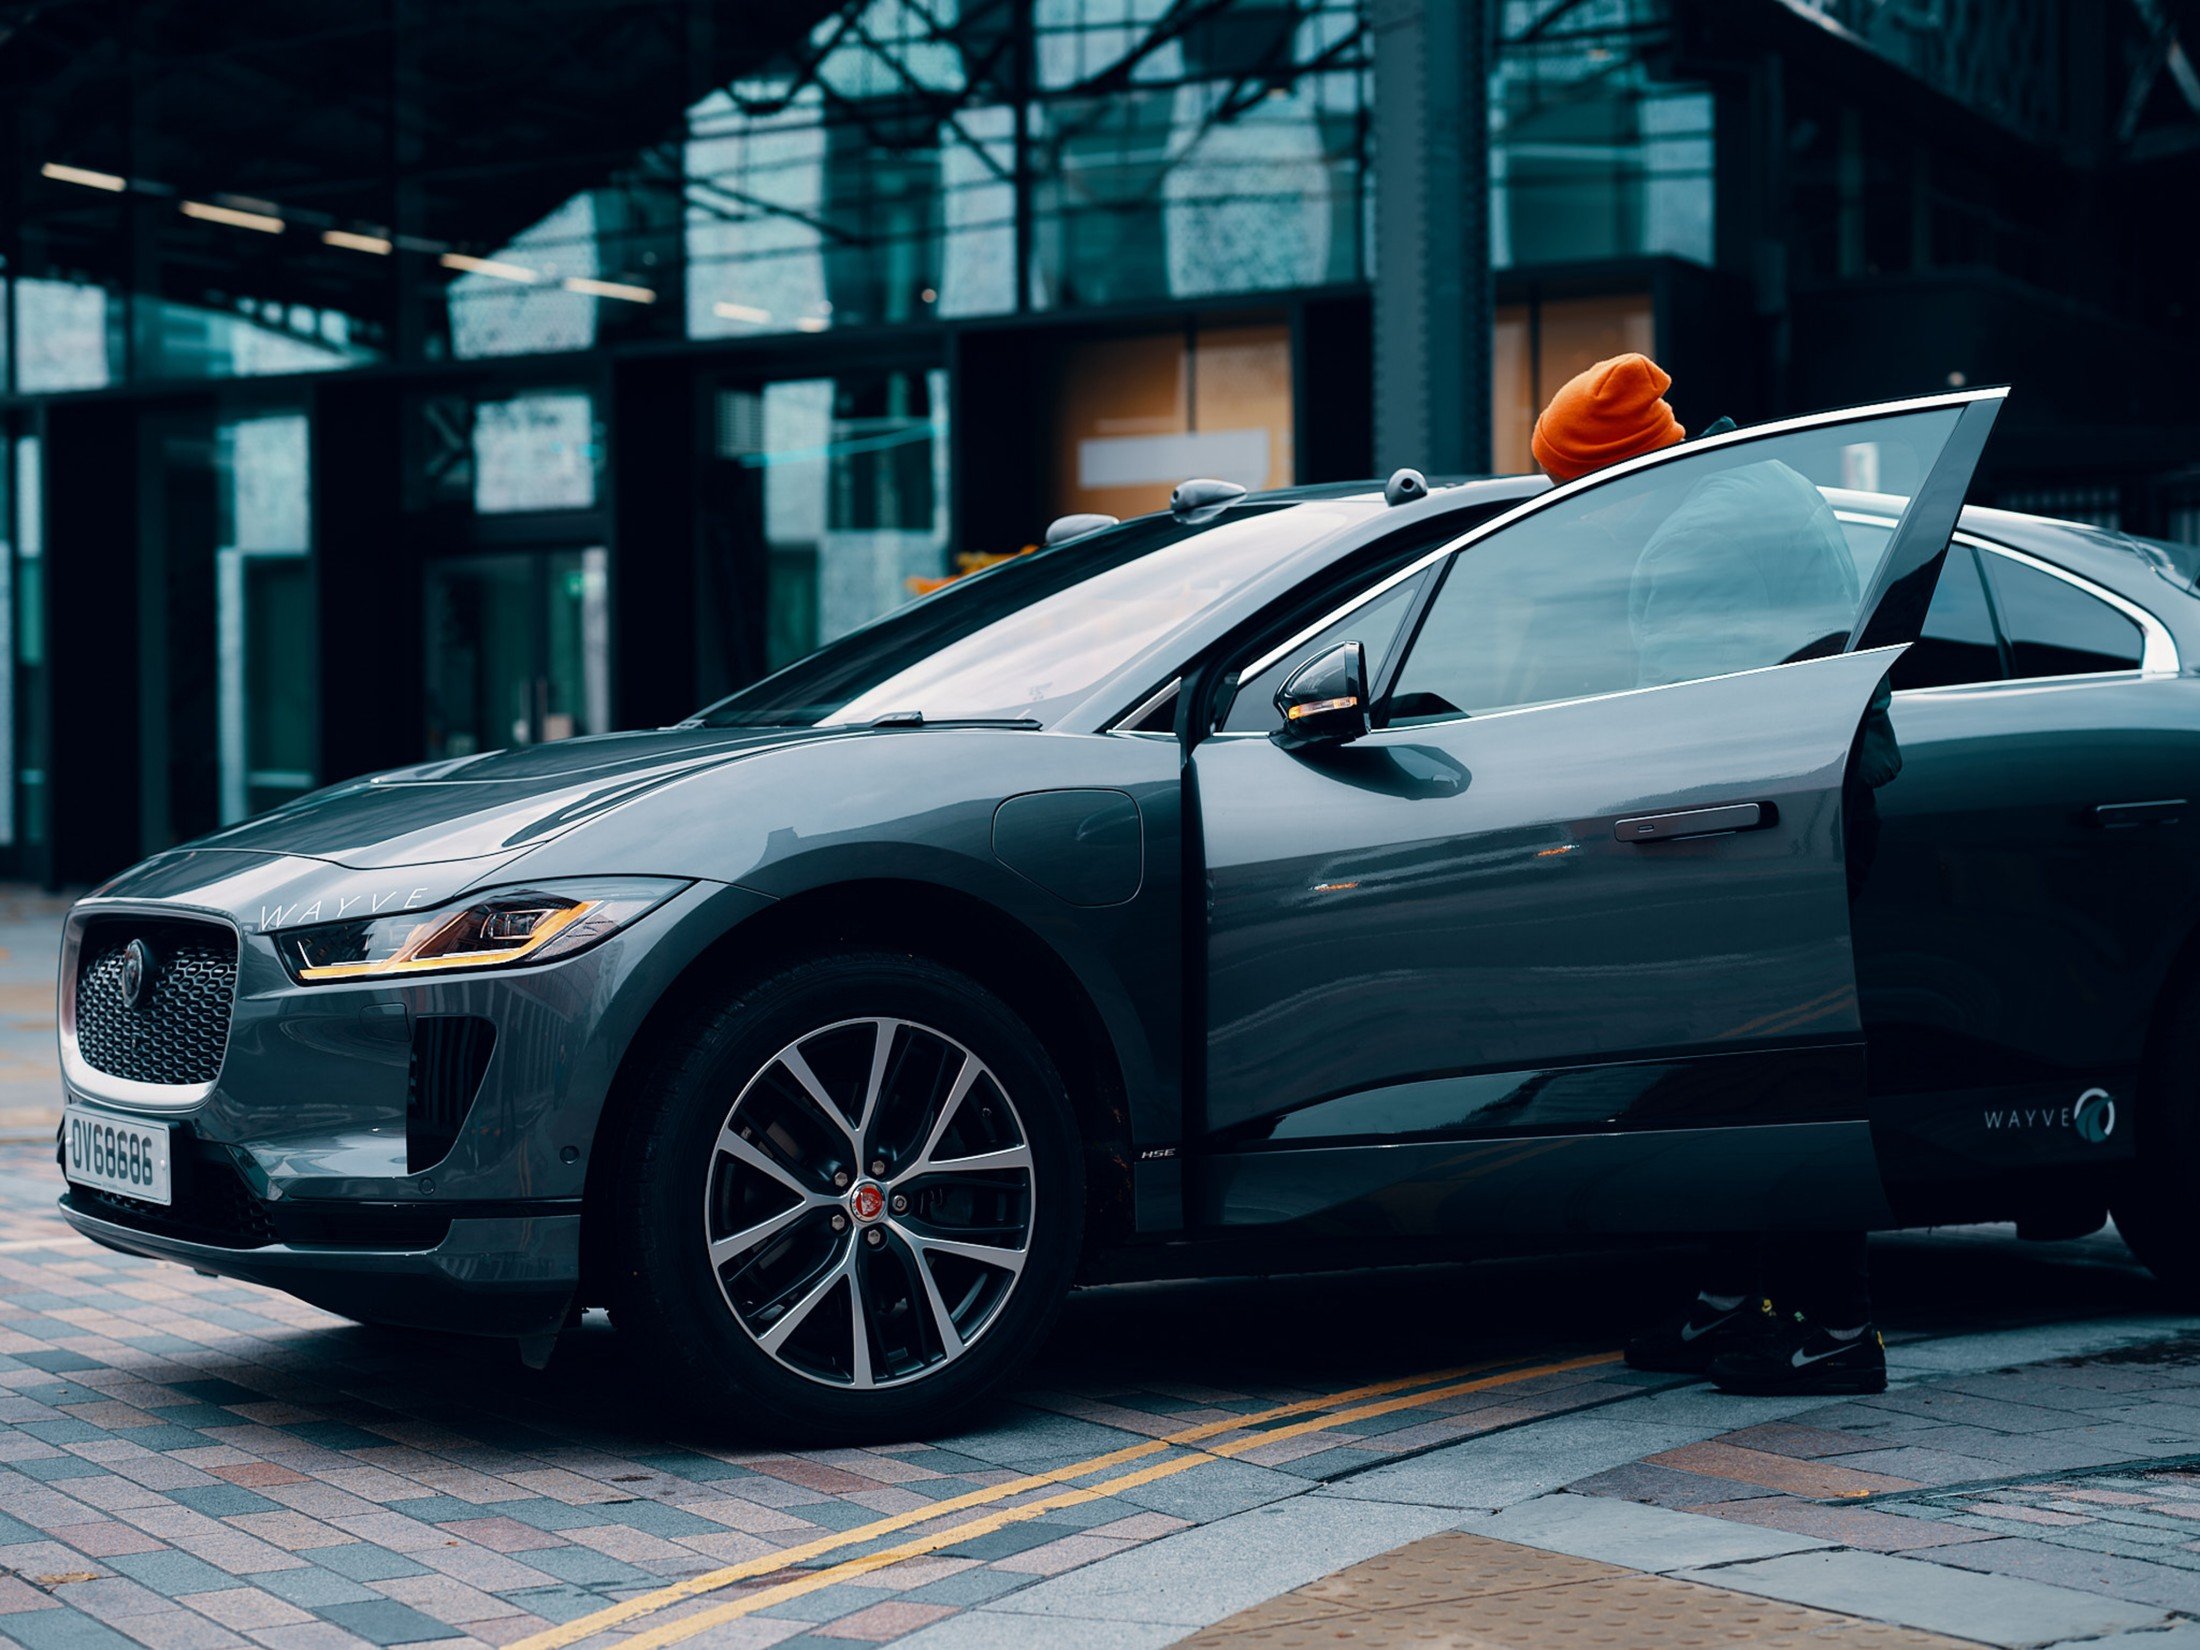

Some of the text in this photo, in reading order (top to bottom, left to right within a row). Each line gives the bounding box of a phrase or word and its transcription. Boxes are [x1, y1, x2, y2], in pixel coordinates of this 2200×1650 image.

[260, 887, 428, 931] WAYVE
[1984, 1107, 2070, 1129] WAYVE
[1141, 1148, 1176, 1159] HSE
